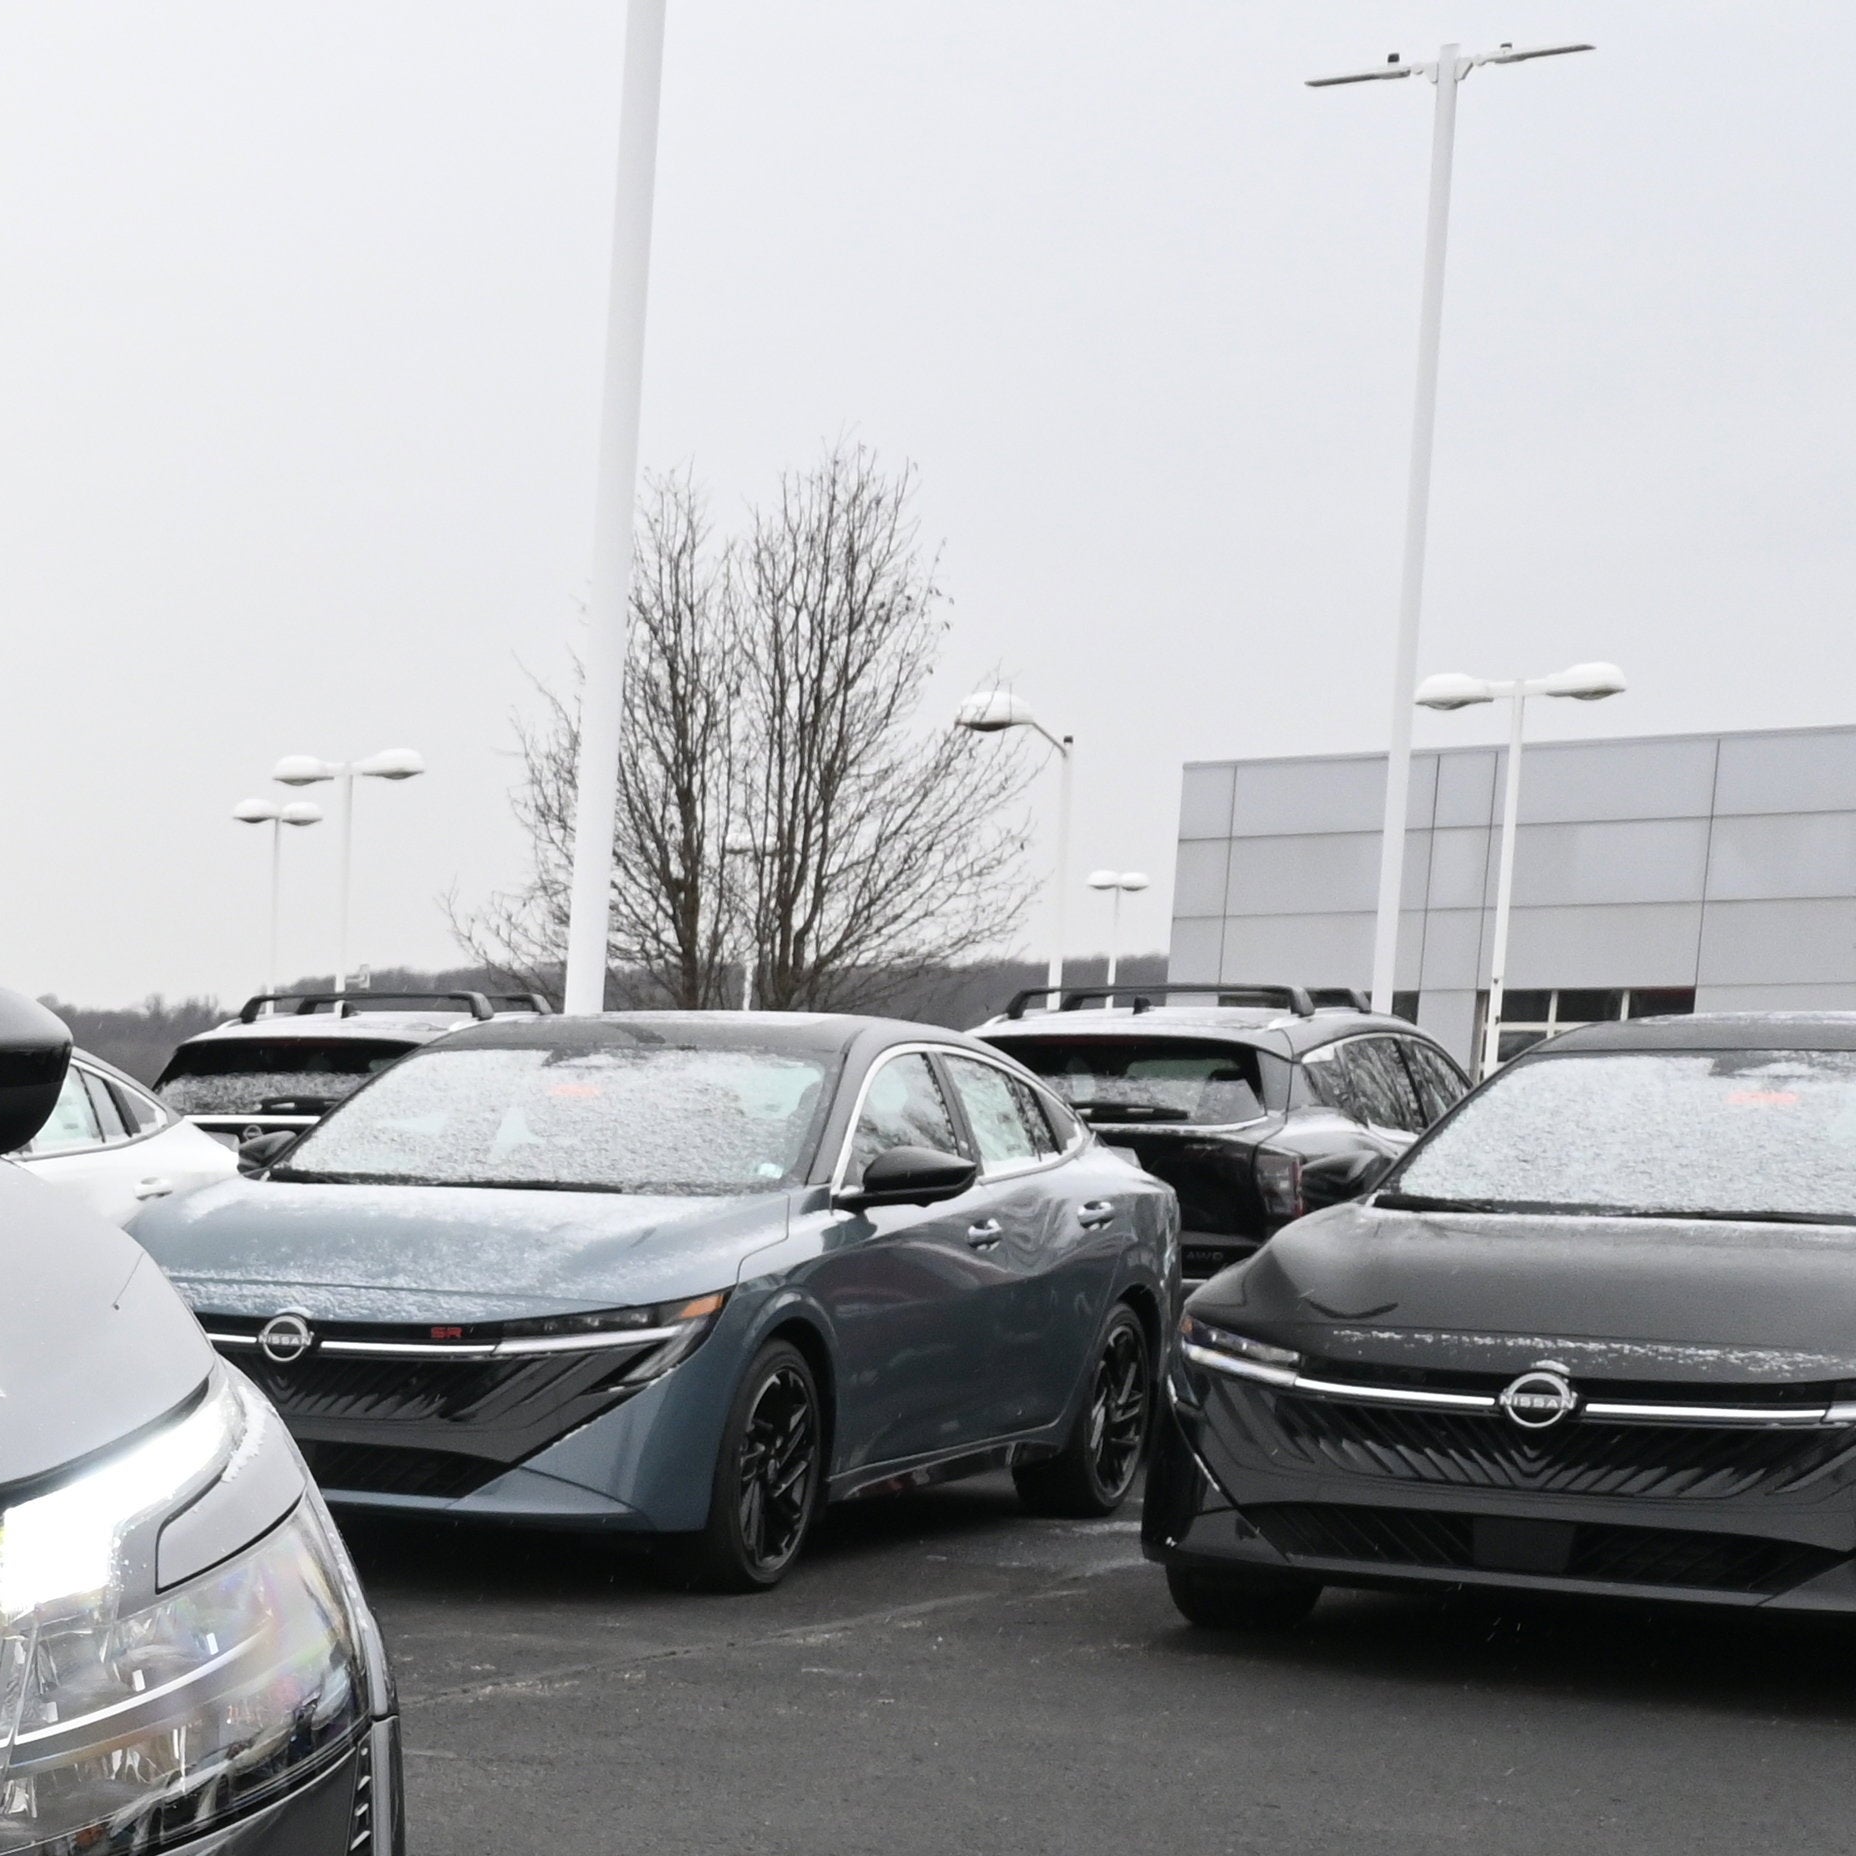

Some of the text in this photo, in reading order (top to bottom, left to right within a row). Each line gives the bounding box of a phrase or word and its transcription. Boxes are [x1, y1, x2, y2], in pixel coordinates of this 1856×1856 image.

[431, 1326, 463, 1340] SR
[258, 1334, 312, 1347] NISSAN
[1499, 1393, 1576, 1410] NISSAN
